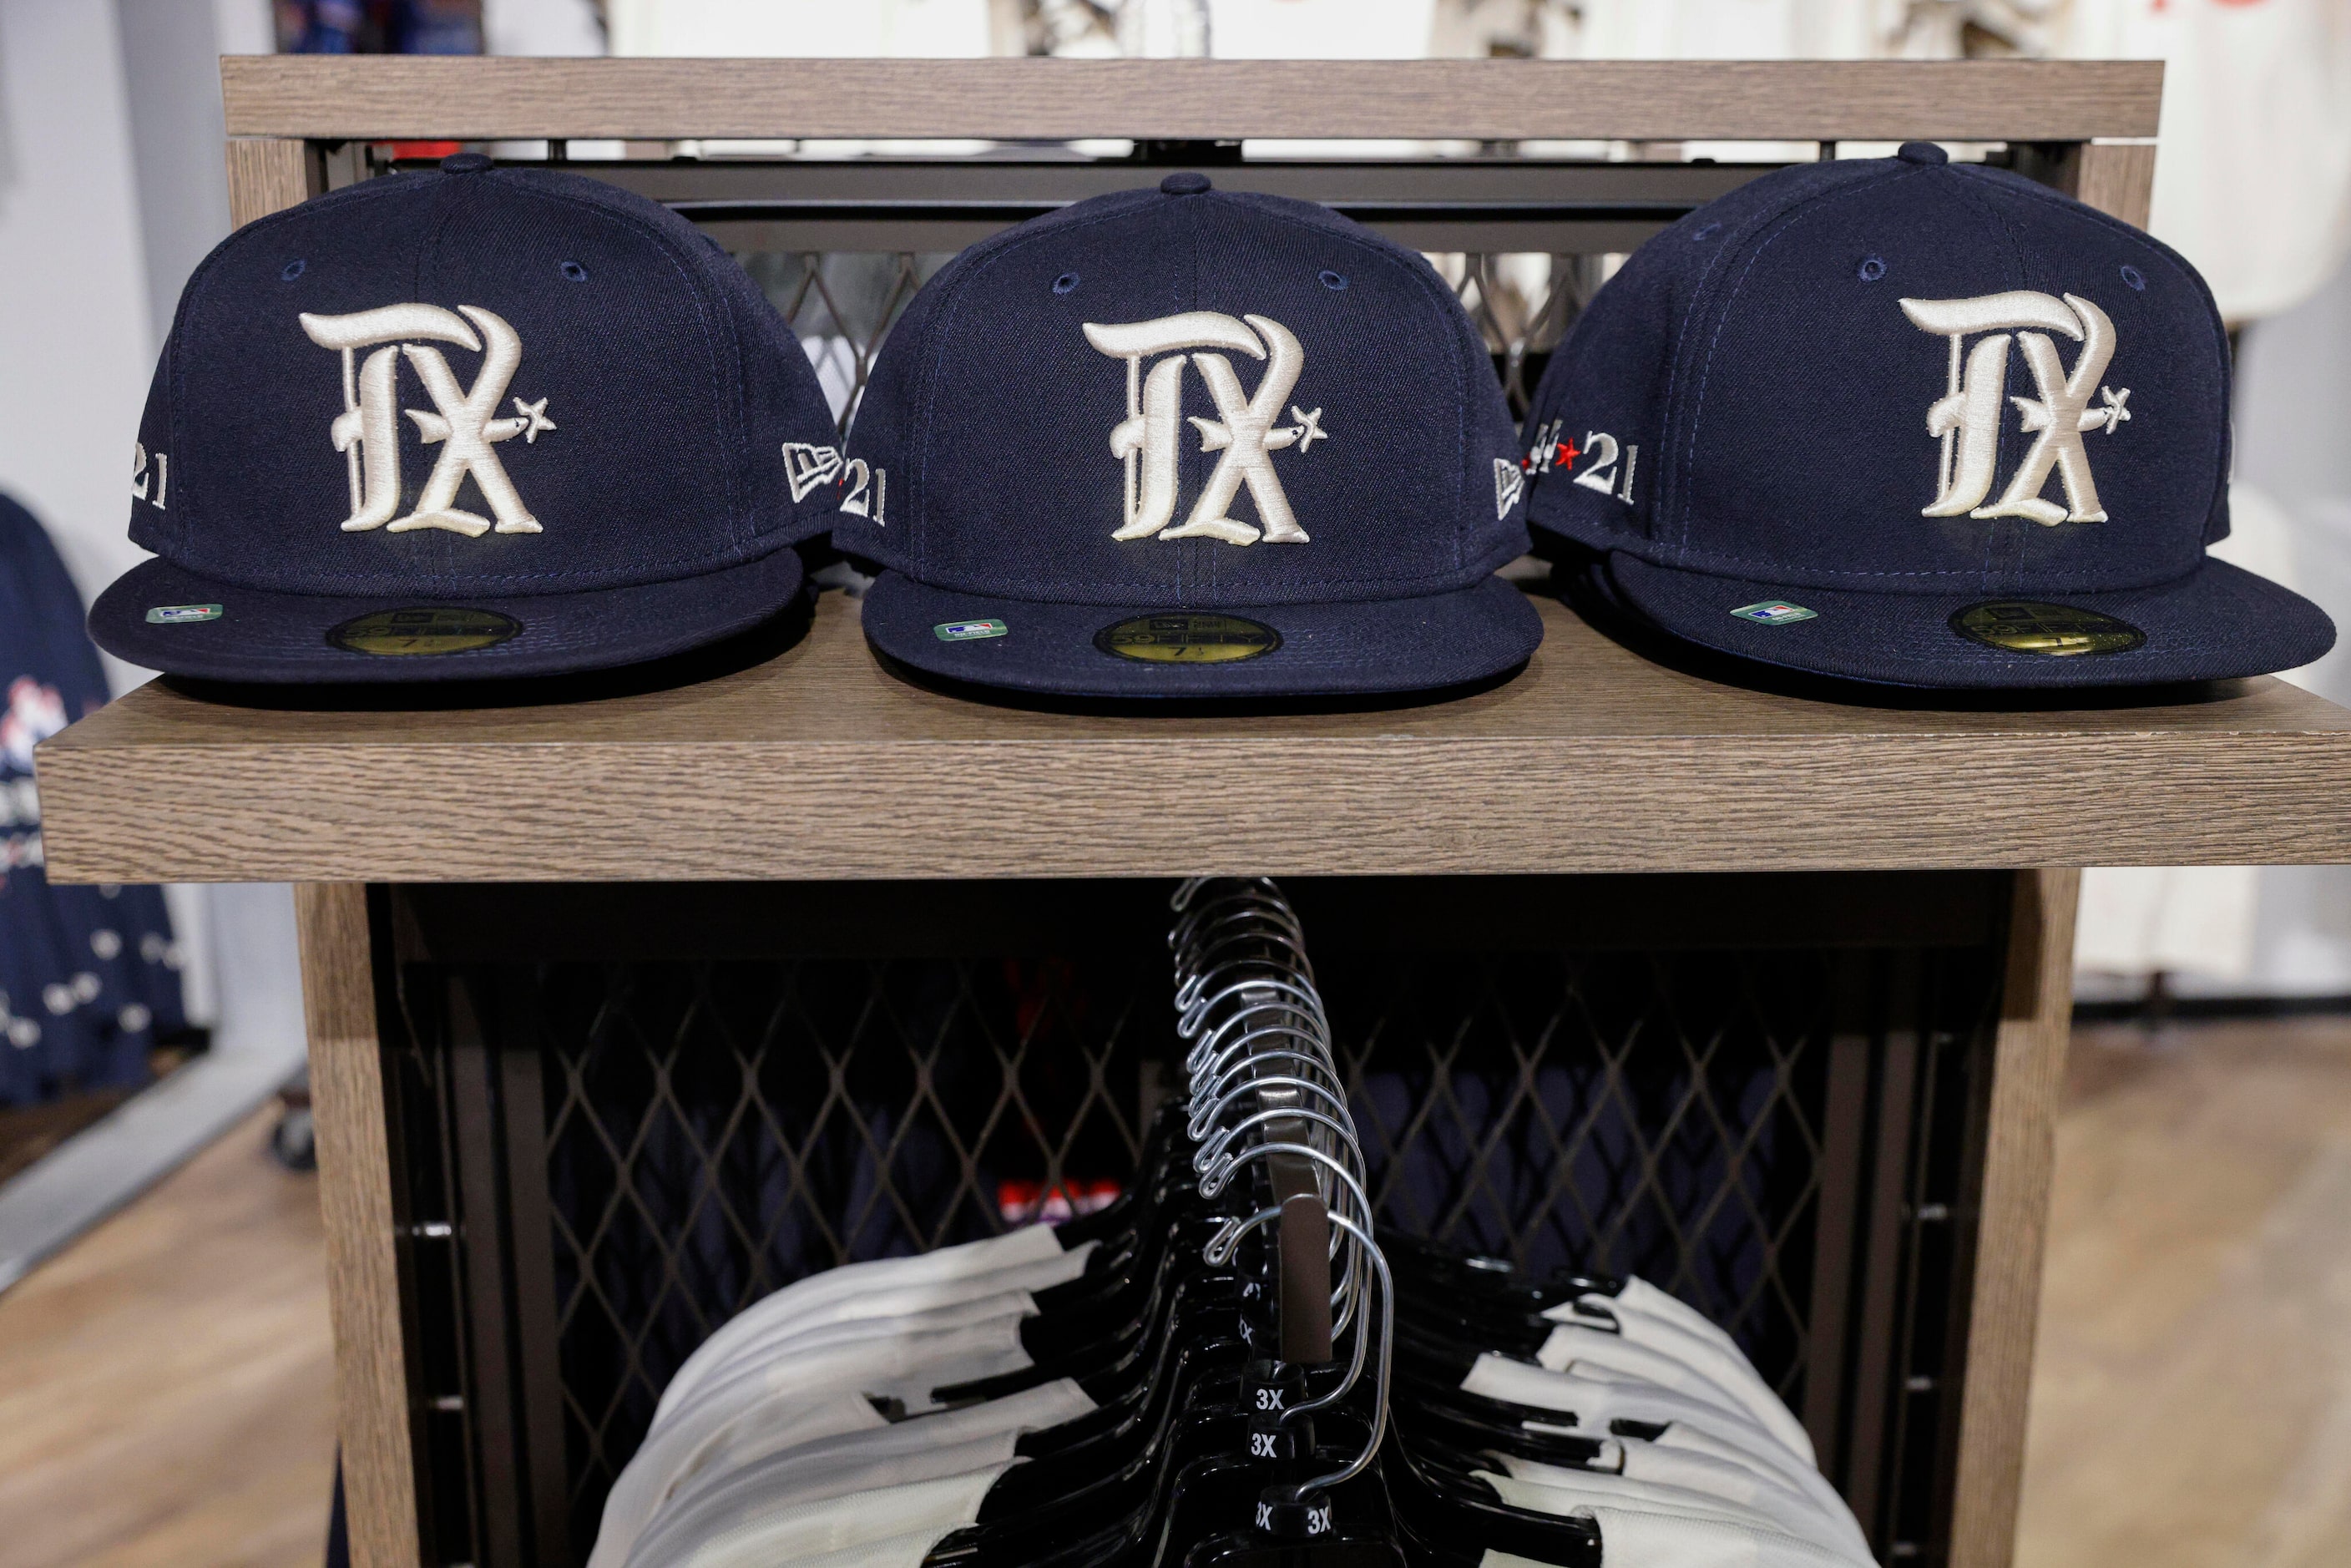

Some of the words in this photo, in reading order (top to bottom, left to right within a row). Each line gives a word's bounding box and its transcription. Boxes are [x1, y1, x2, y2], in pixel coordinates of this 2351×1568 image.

[1572, 431, 1639, 505] 21
[839, 458, 886, 528] 21
[1256, 1388, 1285, 1411] 3X
[1251, 1434, 1277, 1459] 3X
[1256, 1501, 1273, 1531] 3X
[1308, 1505, 1332, 1535] 3X
